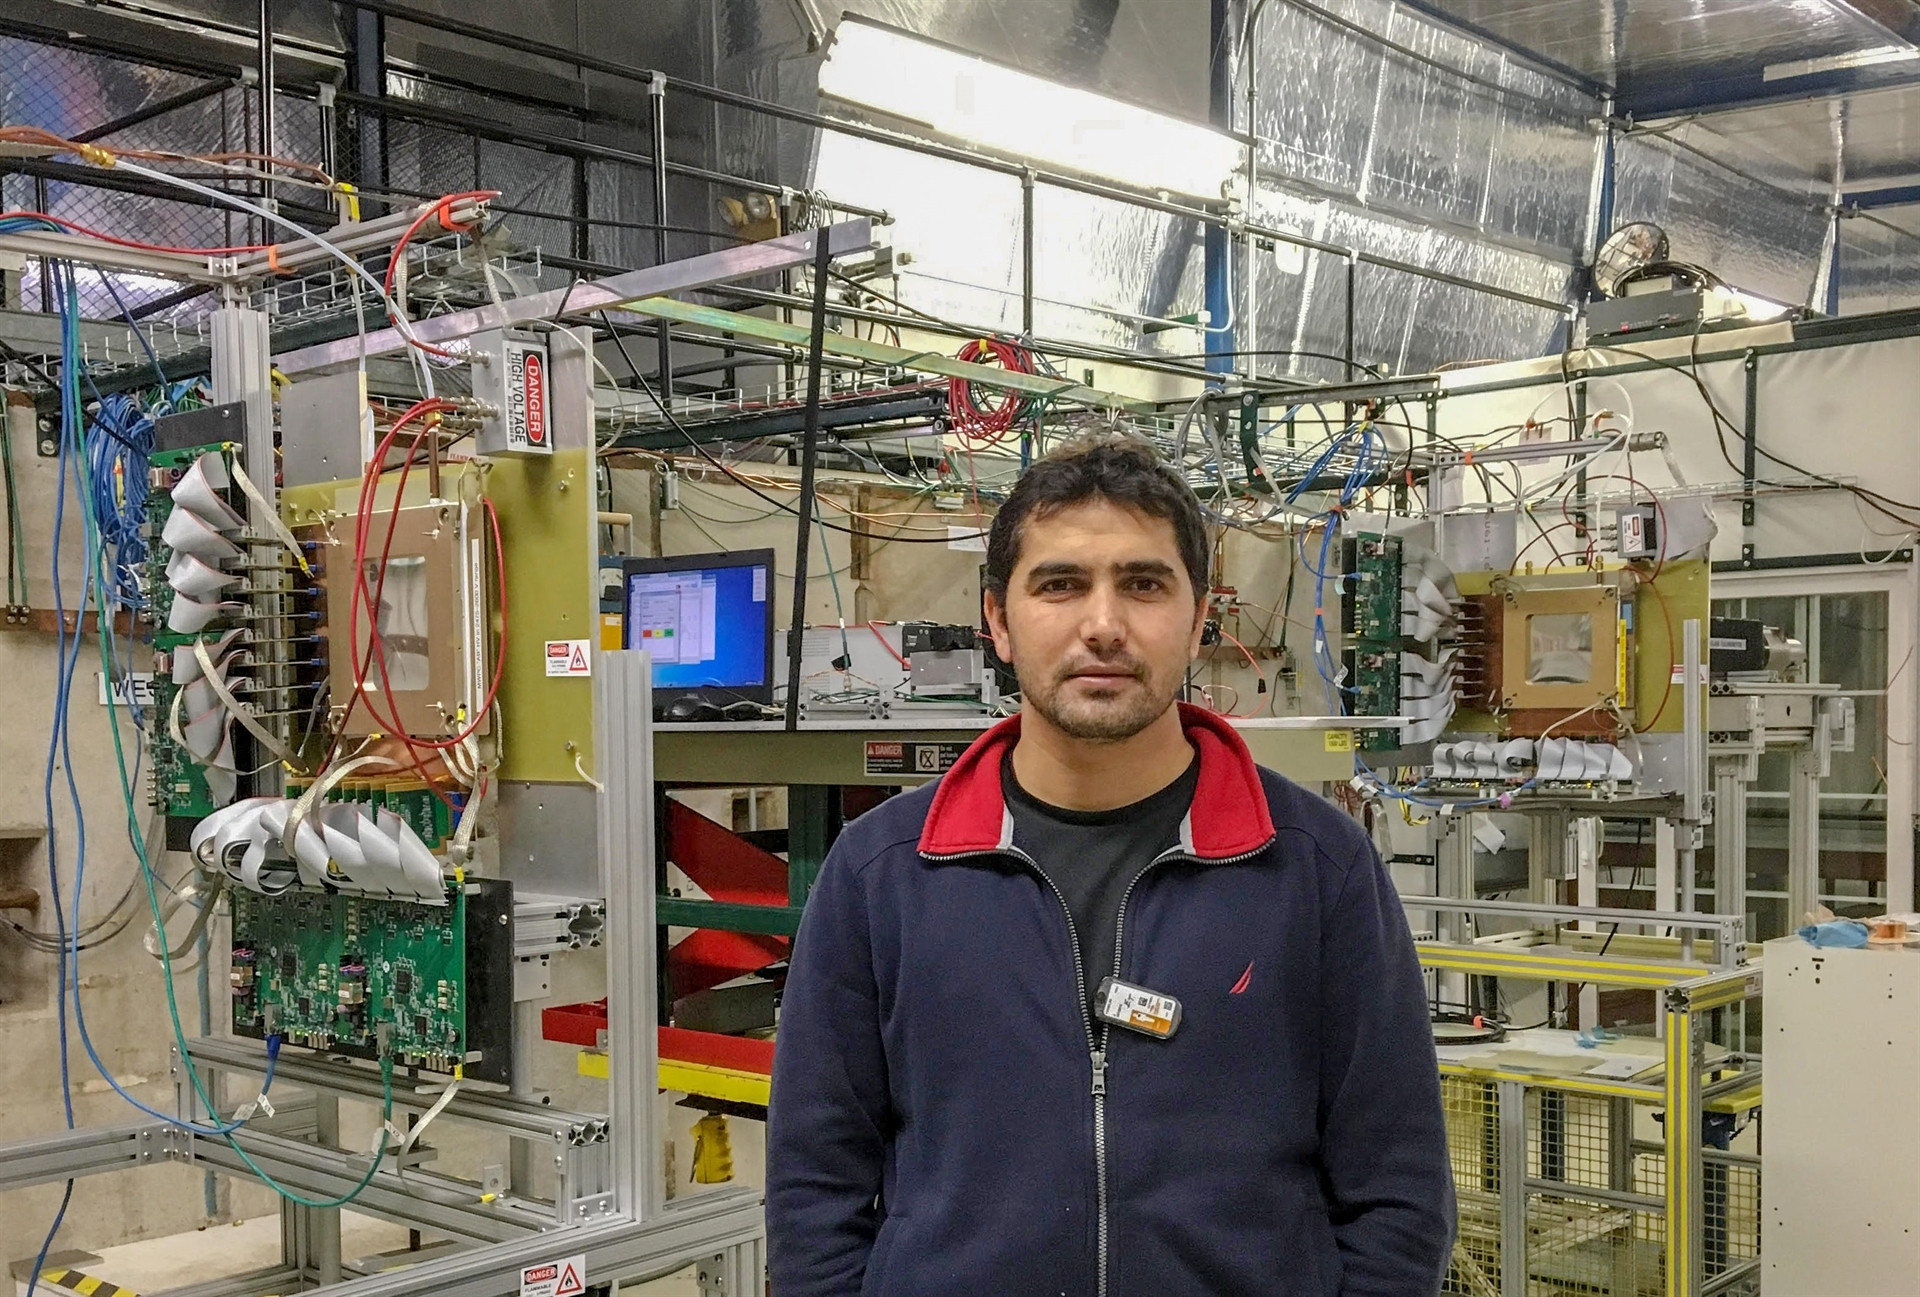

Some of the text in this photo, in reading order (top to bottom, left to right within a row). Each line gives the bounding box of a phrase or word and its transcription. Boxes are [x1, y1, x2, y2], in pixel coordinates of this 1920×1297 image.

[510, 352, 523, 382] HIGH
[527, 365, 541, 432] DANGER
[512, 386, 526, 443] VOLTAGE
[874, 745, 903, 756] DANGER
[526, 1268, 557, 1281] DANGER
[525, 1283, 552, 1293] FLAMMABLE
